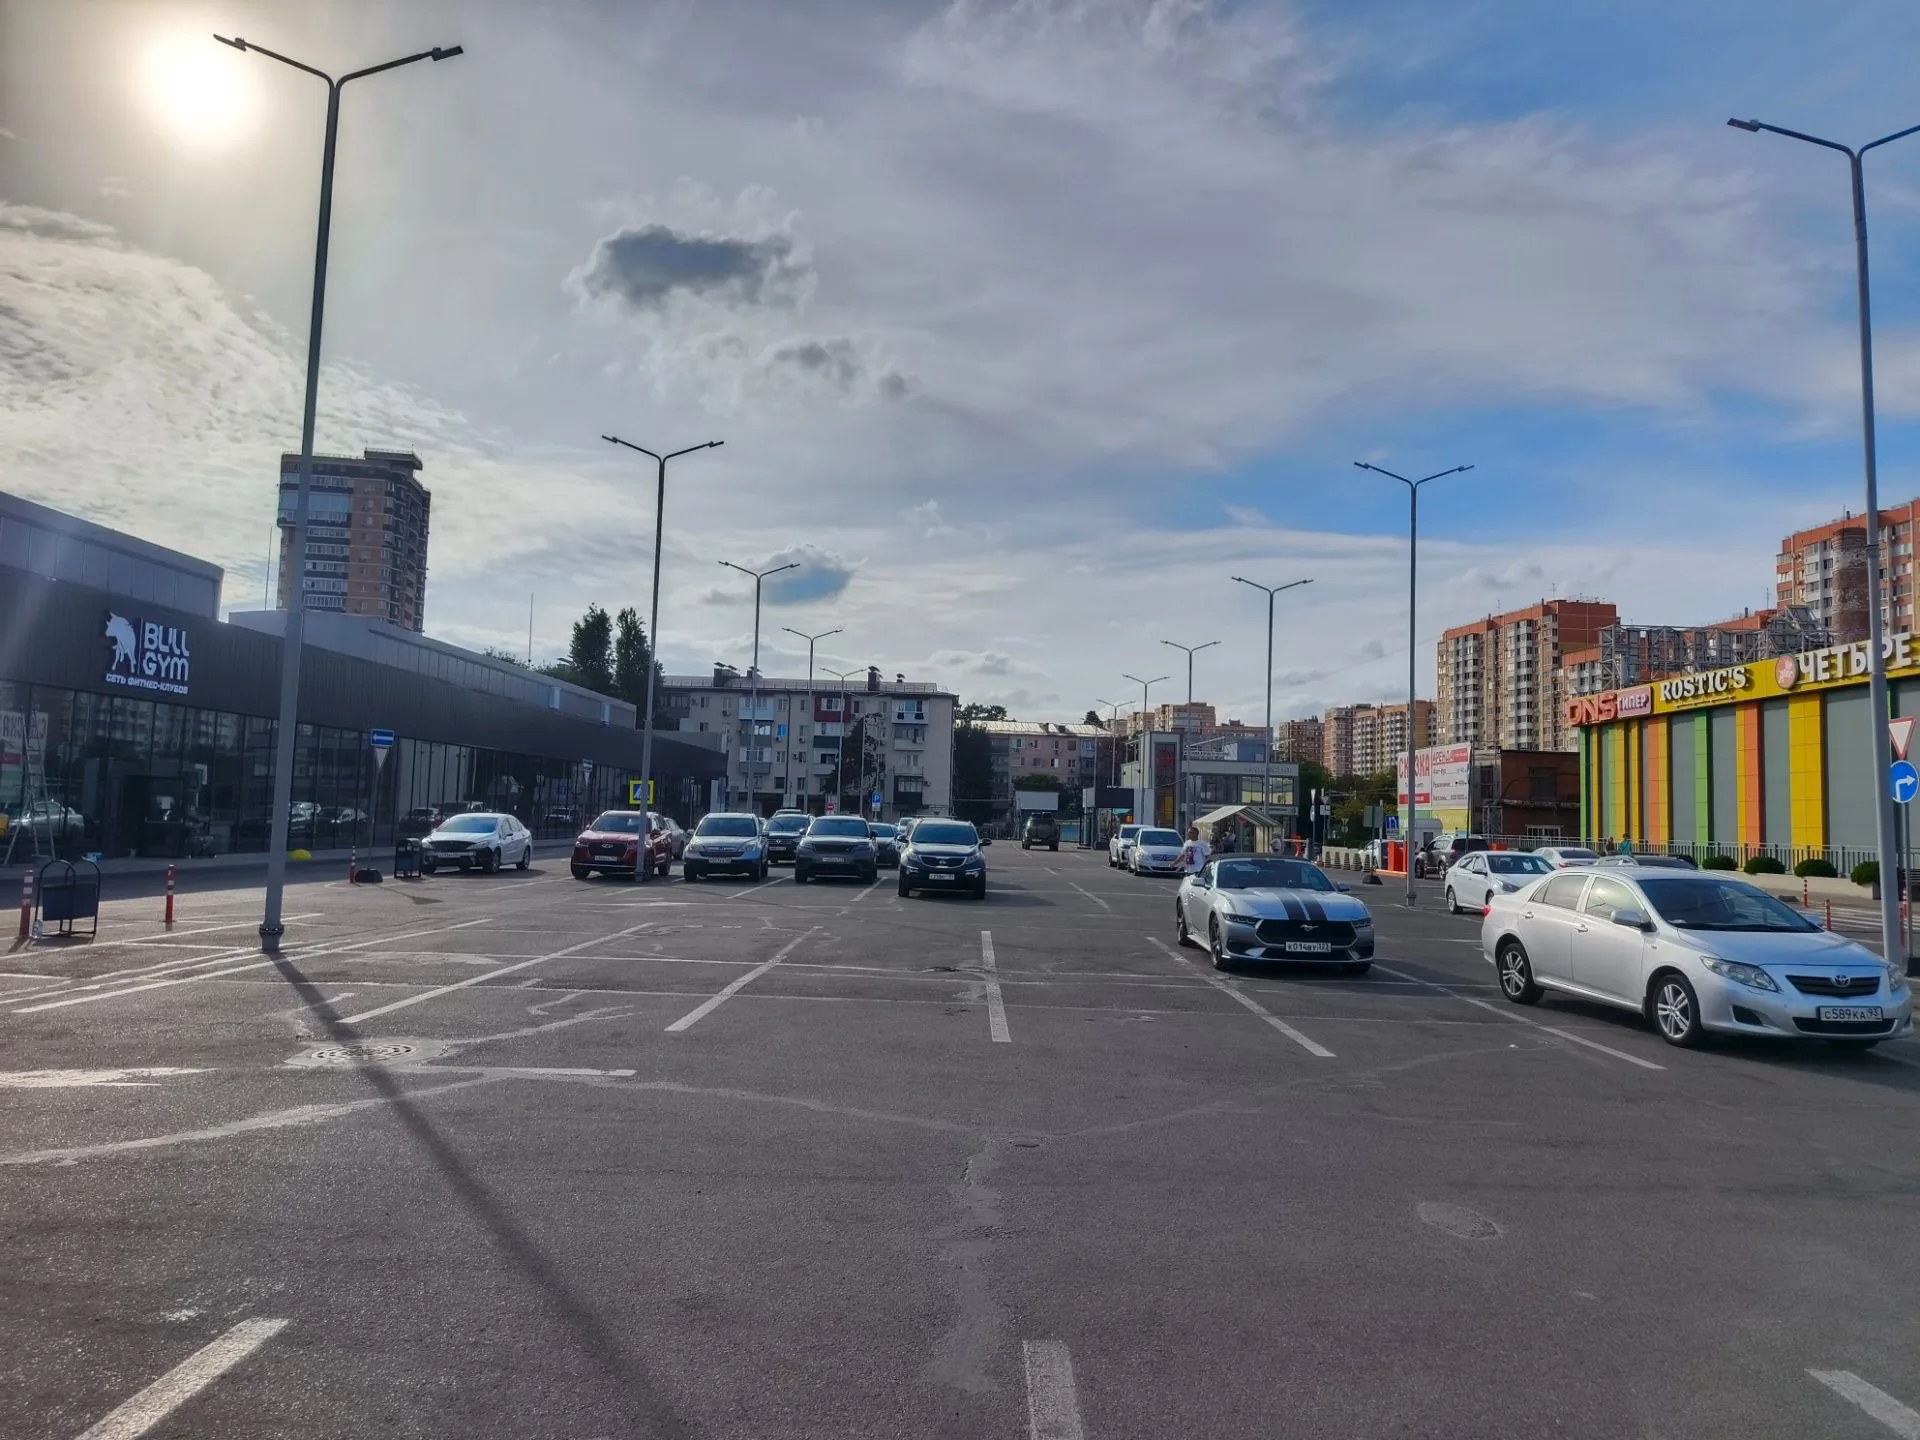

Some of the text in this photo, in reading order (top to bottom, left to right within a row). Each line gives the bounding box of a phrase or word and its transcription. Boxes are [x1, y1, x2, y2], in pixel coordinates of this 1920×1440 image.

[144, 622, 189, 657] BULL
[142, 651, 189, 681] GYM
[1797, 632, 1911, 682] ЧЕТЫРЕ
[106, 673, 189, 694] СЕТЬ ФИТНЕС-КЛУБОВ
[1660, 667, 1747, 701] ROSTIC'S
[1567, 692, 1617, 725] DNS
[1618, 694, 1649, 714] ГИПЕР
[1399, 754, 1430, 778] СКЗКА
